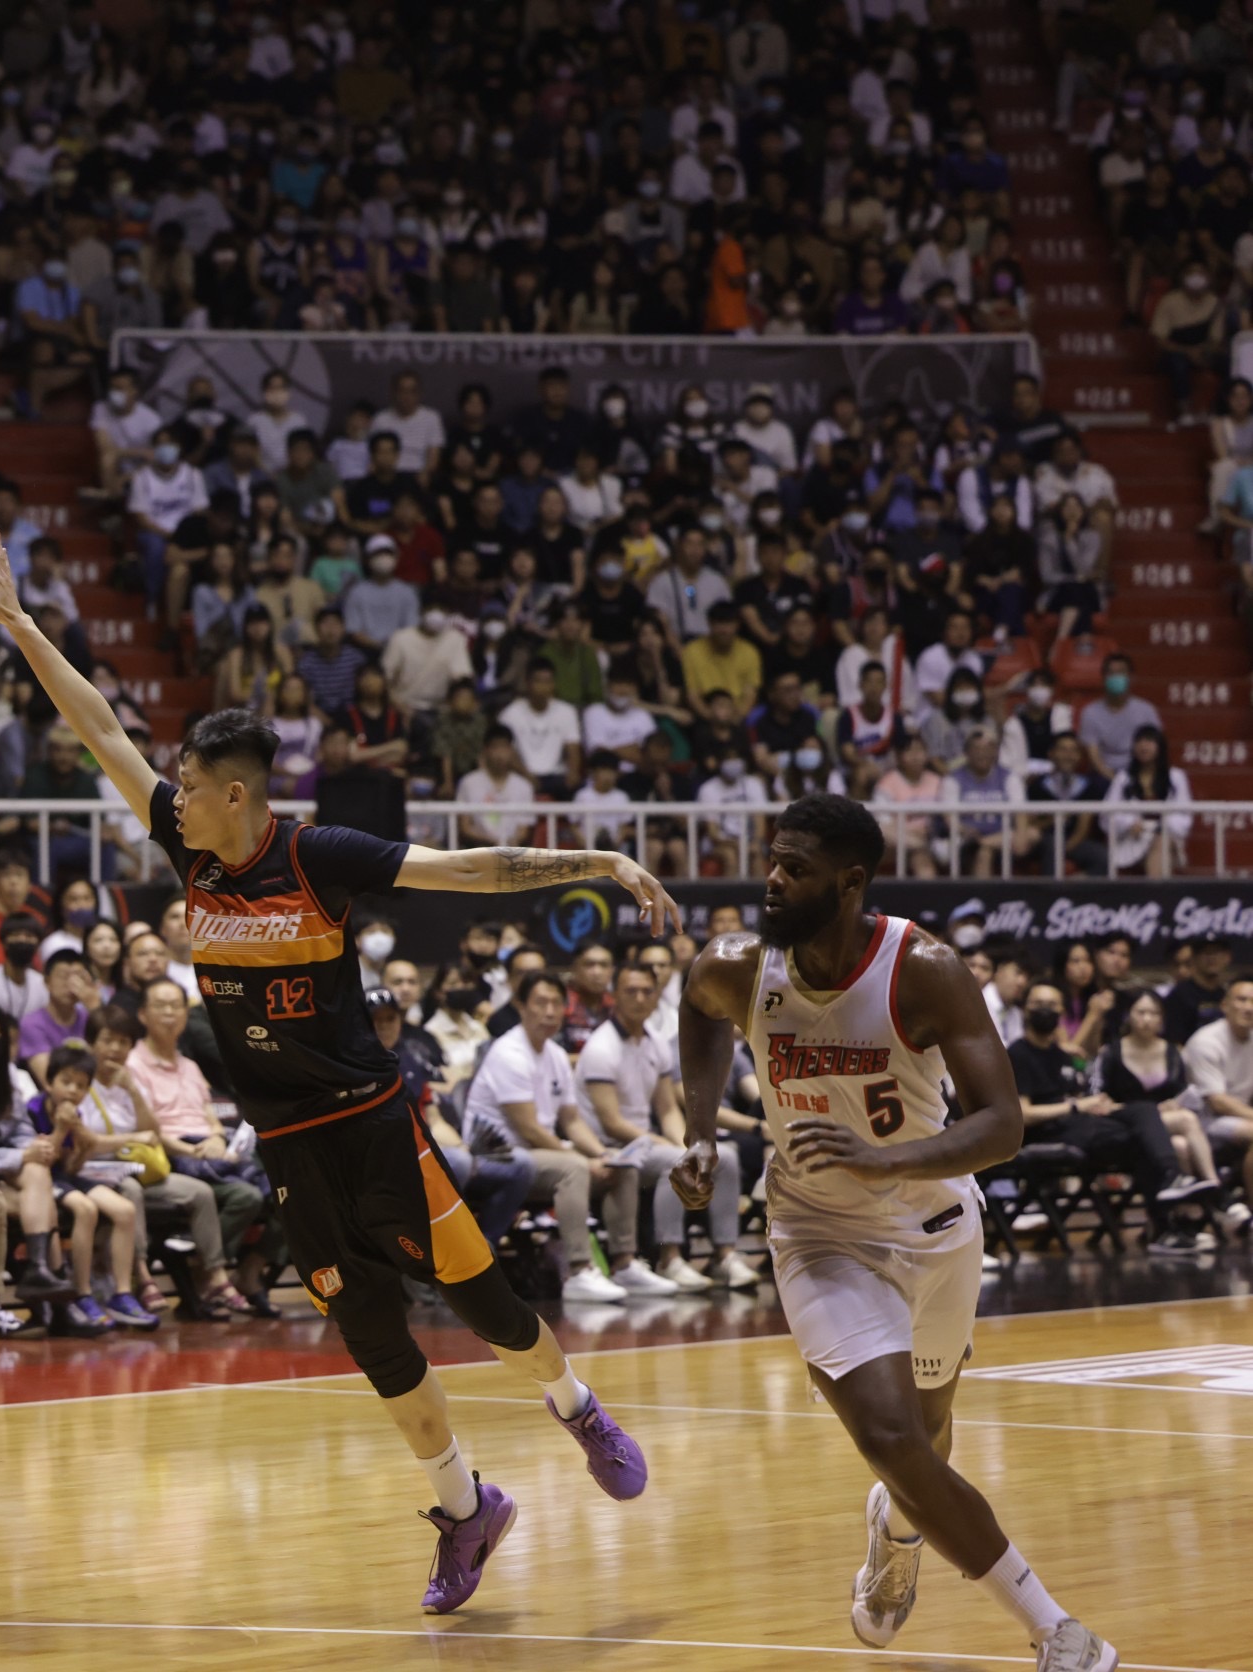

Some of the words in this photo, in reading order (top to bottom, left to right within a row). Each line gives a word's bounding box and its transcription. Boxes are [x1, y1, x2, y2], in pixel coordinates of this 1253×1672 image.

[265, 975, 317, 1021] 12
[767, 1033, 891, 1090] STEELERS
[863, 1077, 906, 1139] 5
